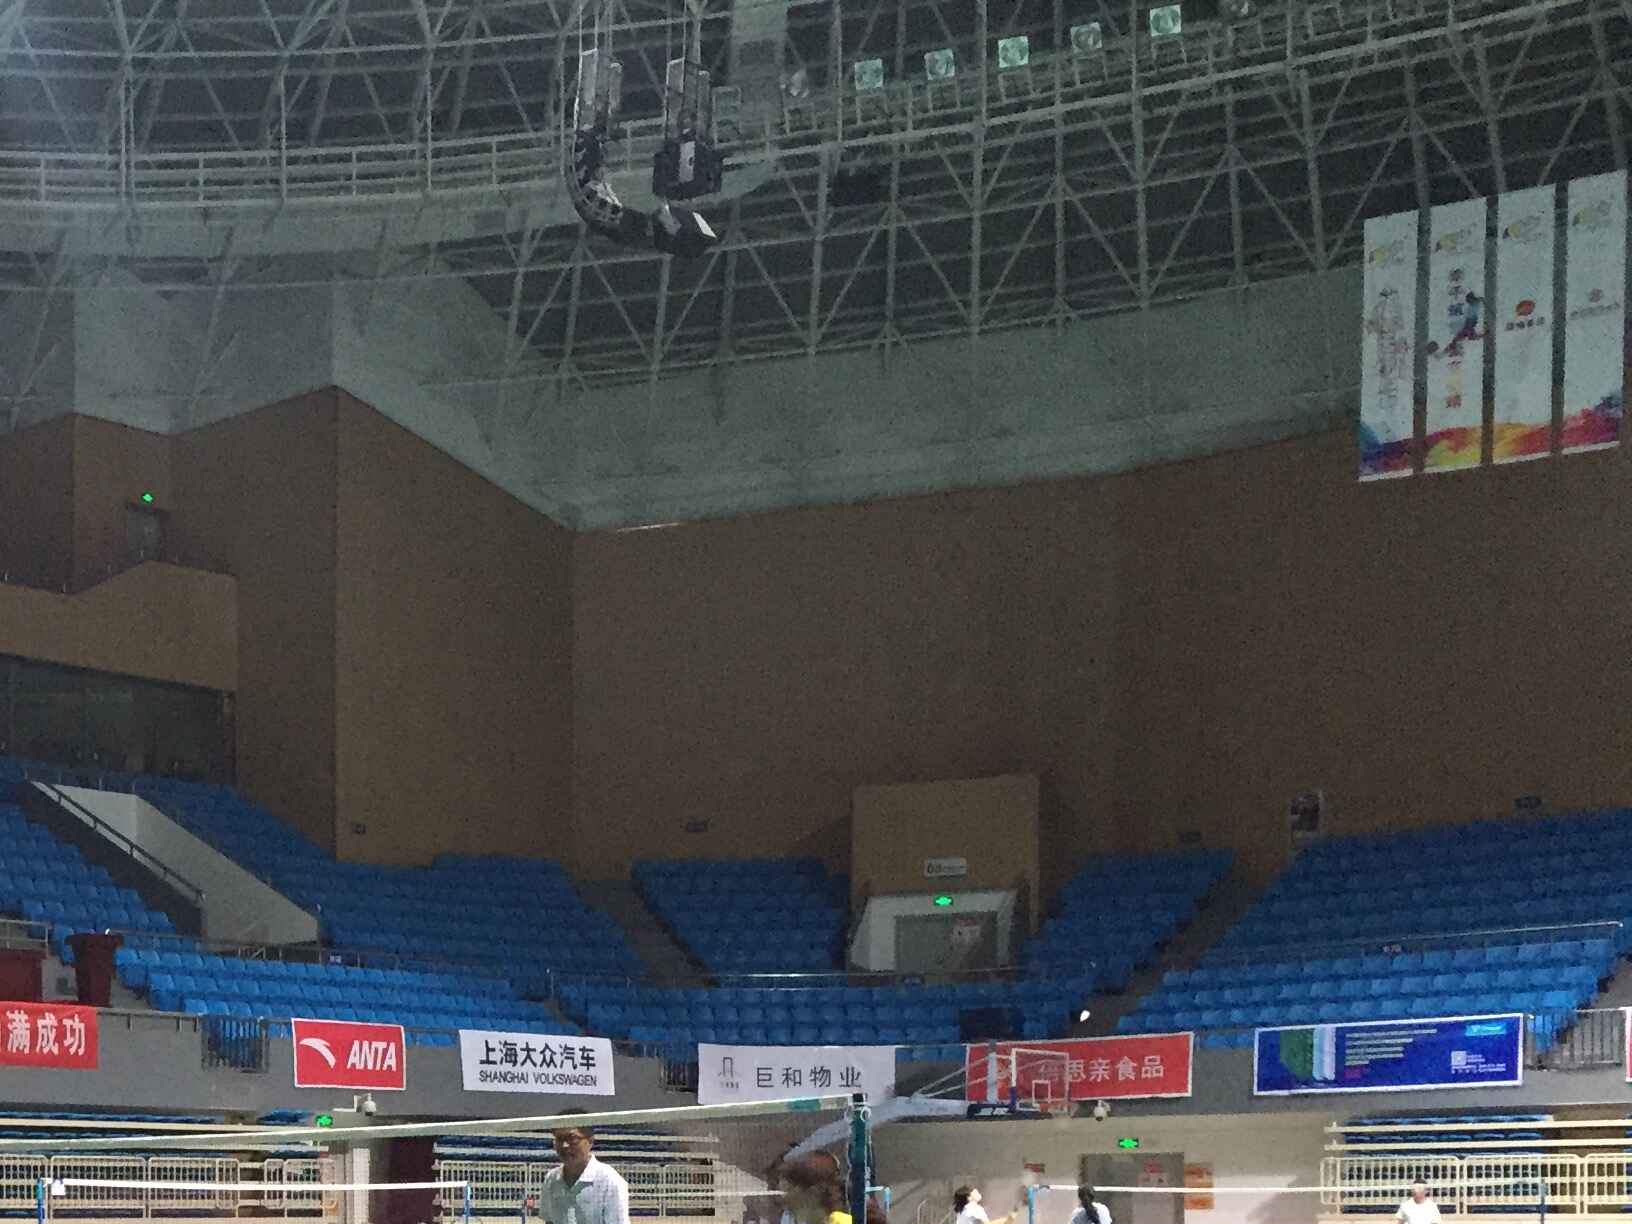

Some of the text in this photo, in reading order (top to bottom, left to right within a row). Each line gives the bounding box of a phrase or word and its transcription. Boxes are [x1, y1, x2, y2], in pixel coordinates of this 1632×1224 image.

[346, 1039, 397, 1072] ANTA
[479, 1039, 597, 1071] 上海大众汽车
[479, 1069, 597, 1087] SHANGHAI VOLKSWAGEN
[756, 1065, 863, 1089] 巨和物业
